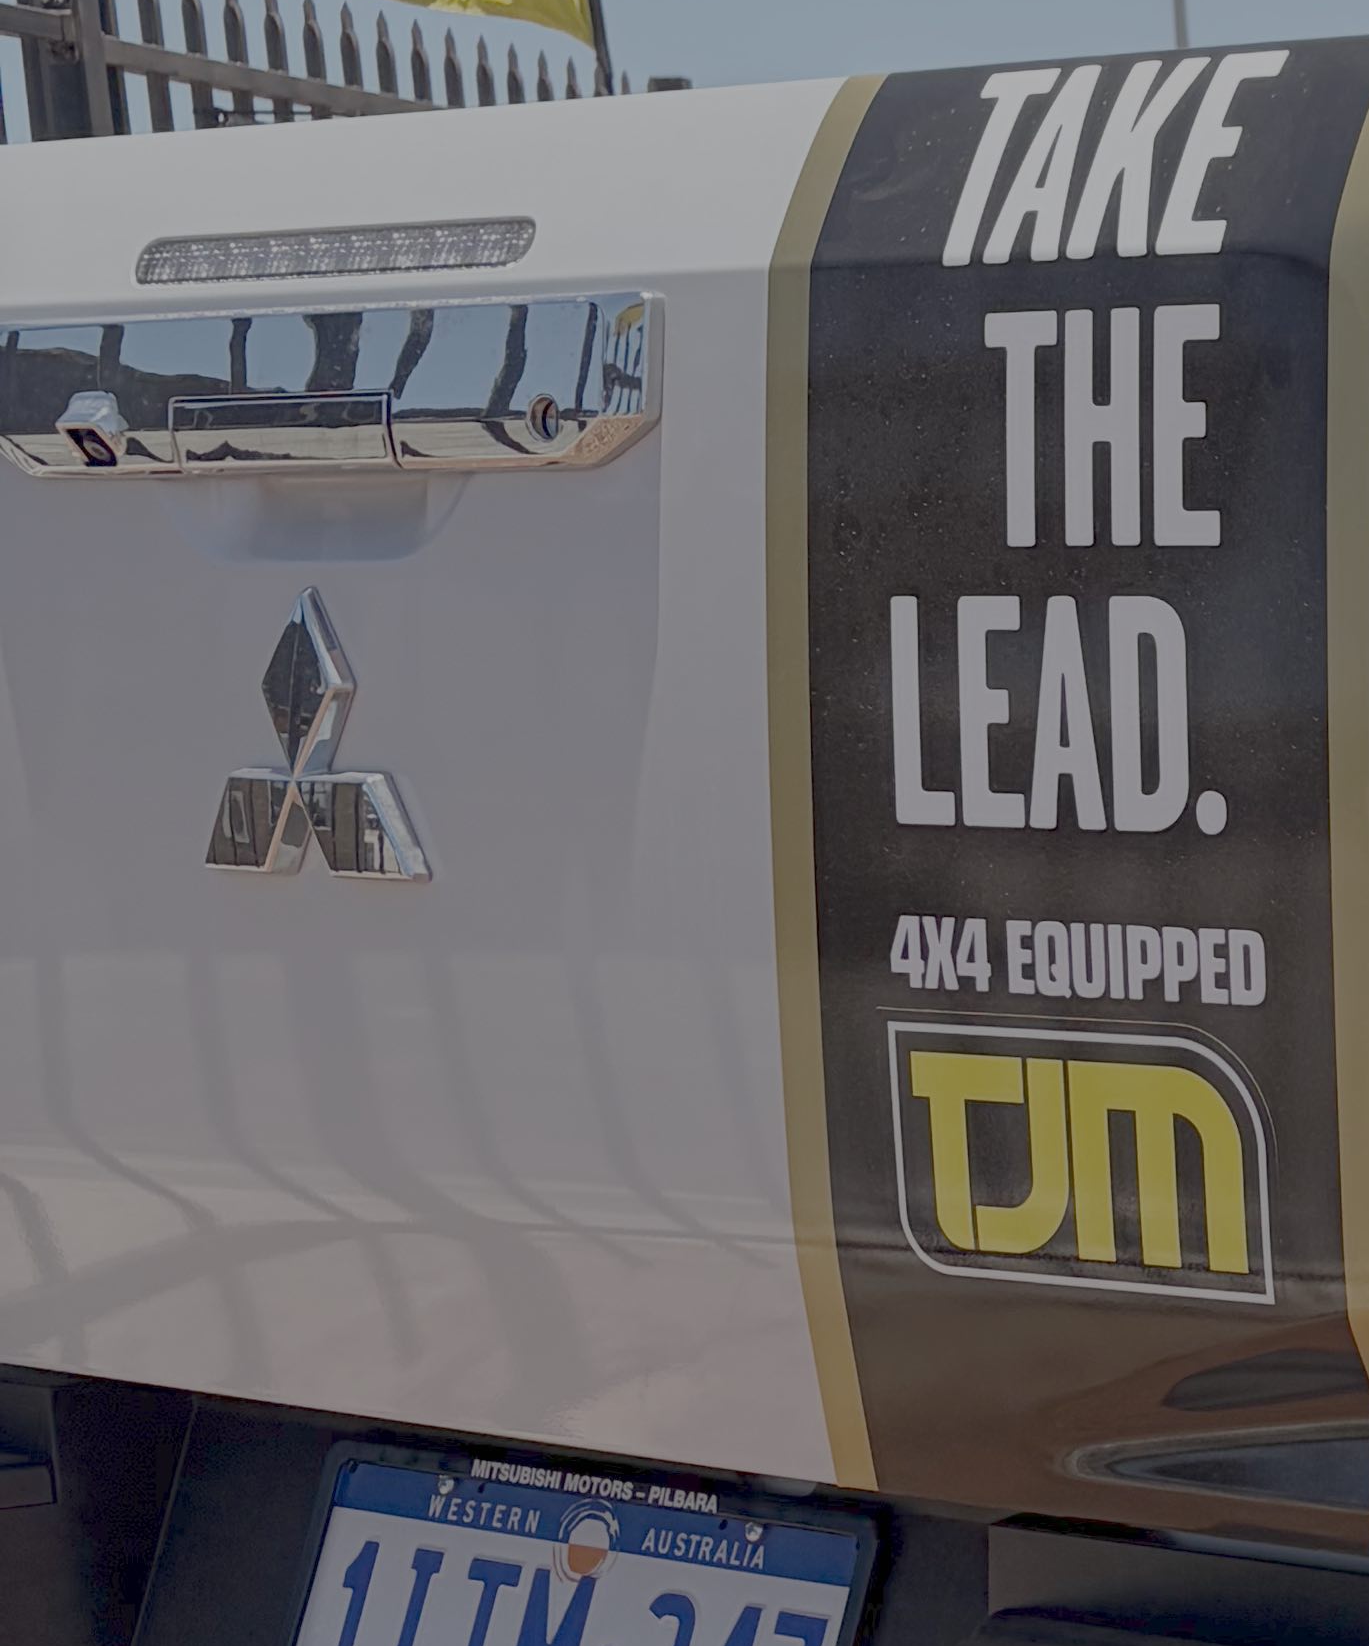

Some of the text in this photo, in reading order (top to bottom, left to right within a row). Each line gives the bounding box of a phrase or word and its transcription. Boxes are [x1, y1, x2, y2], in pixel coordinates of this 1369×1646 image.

[942, 49, 1290, 267] TAKE
[984, 303, 1221, 548] THE
[889, 595, 1228, 835] LEAD.
[889, 914, 1267, 1007] 4X4 EQUIPPED
[910, 1050, 1250, 1275] TJM
[428, 1494, 765, 1570] WESTERN AUSTRALIA
[470, 1458, 562, 1490] MITSUBISHI
[563, 1473, 634, 1501] MOTORS
[647, 1485, 719, 1515] PILBARA
